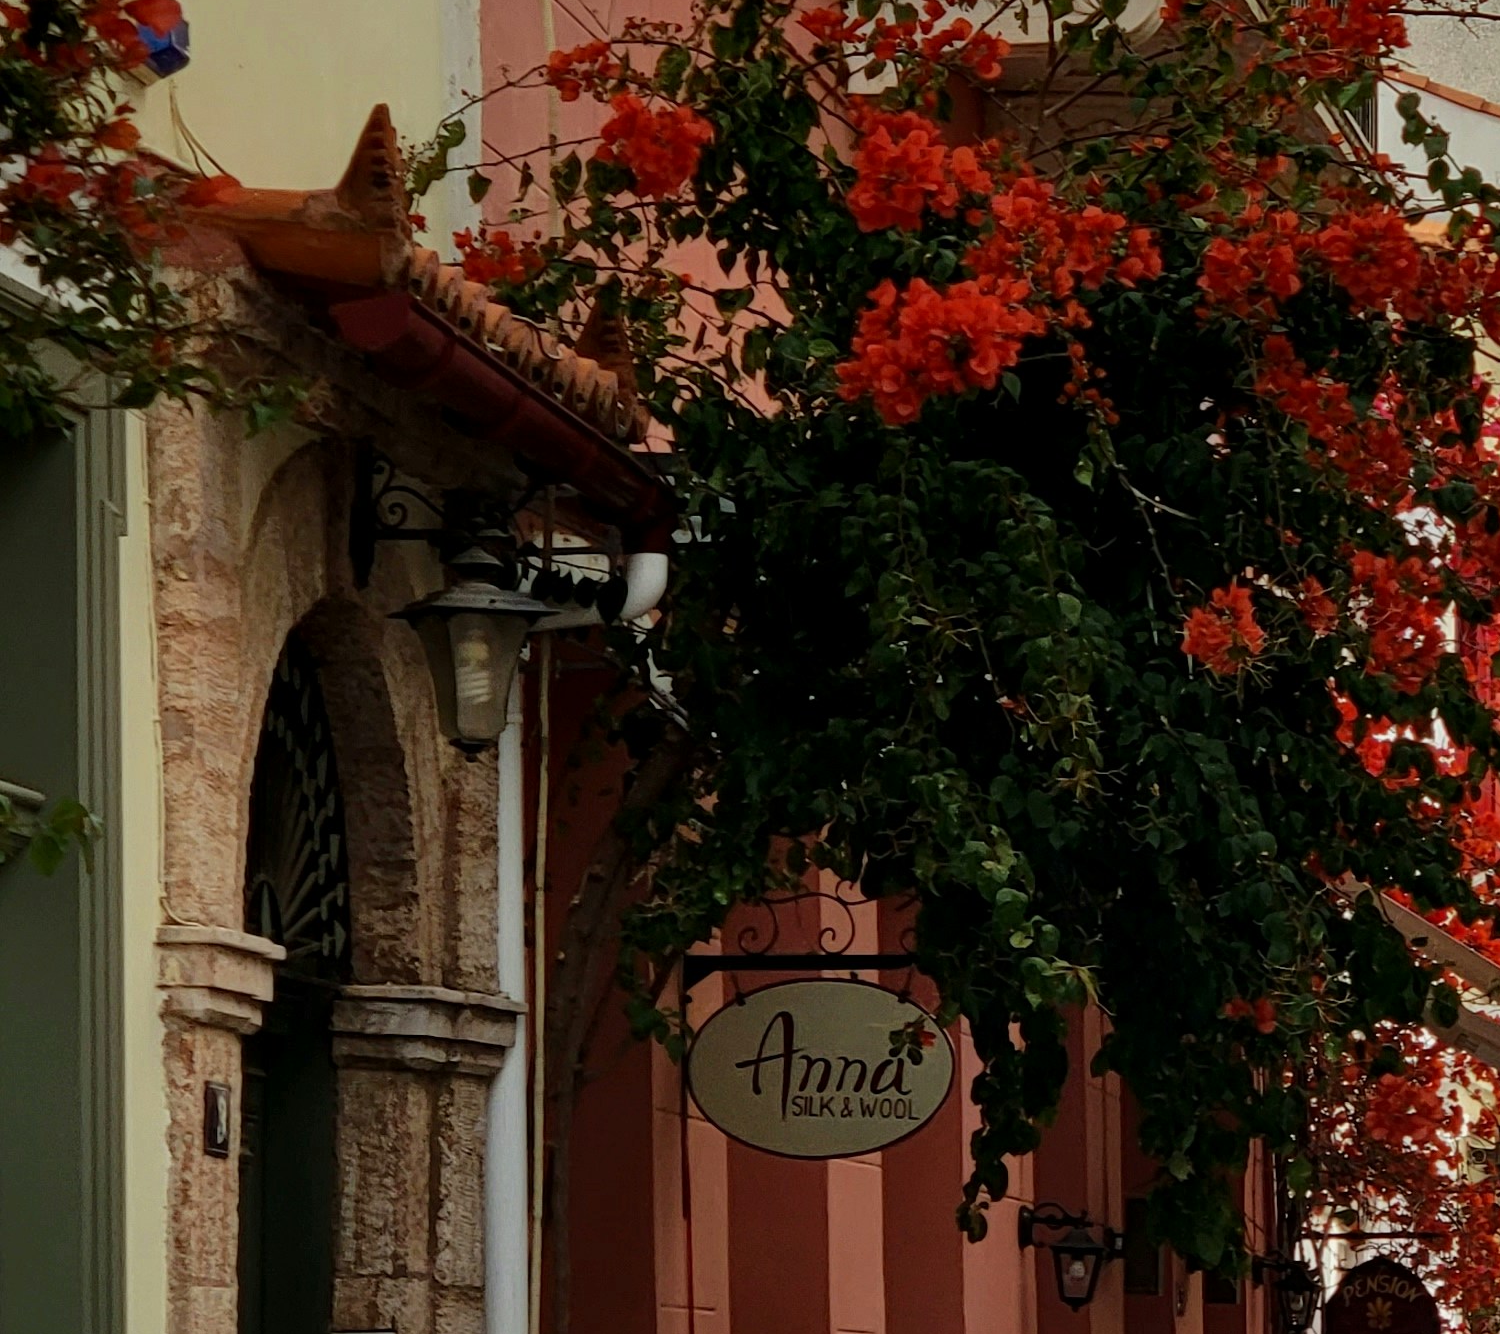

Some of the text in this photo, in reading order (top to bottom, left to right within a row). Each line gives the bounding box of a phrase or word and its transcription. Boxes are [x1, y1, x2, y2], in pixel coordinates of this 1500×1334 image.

[735, 1011, 912, 1121] Anna
[791, 1095, 921, 1121] SILK & WOOL
[1342, 1275, 1423, 1307] PENSION
